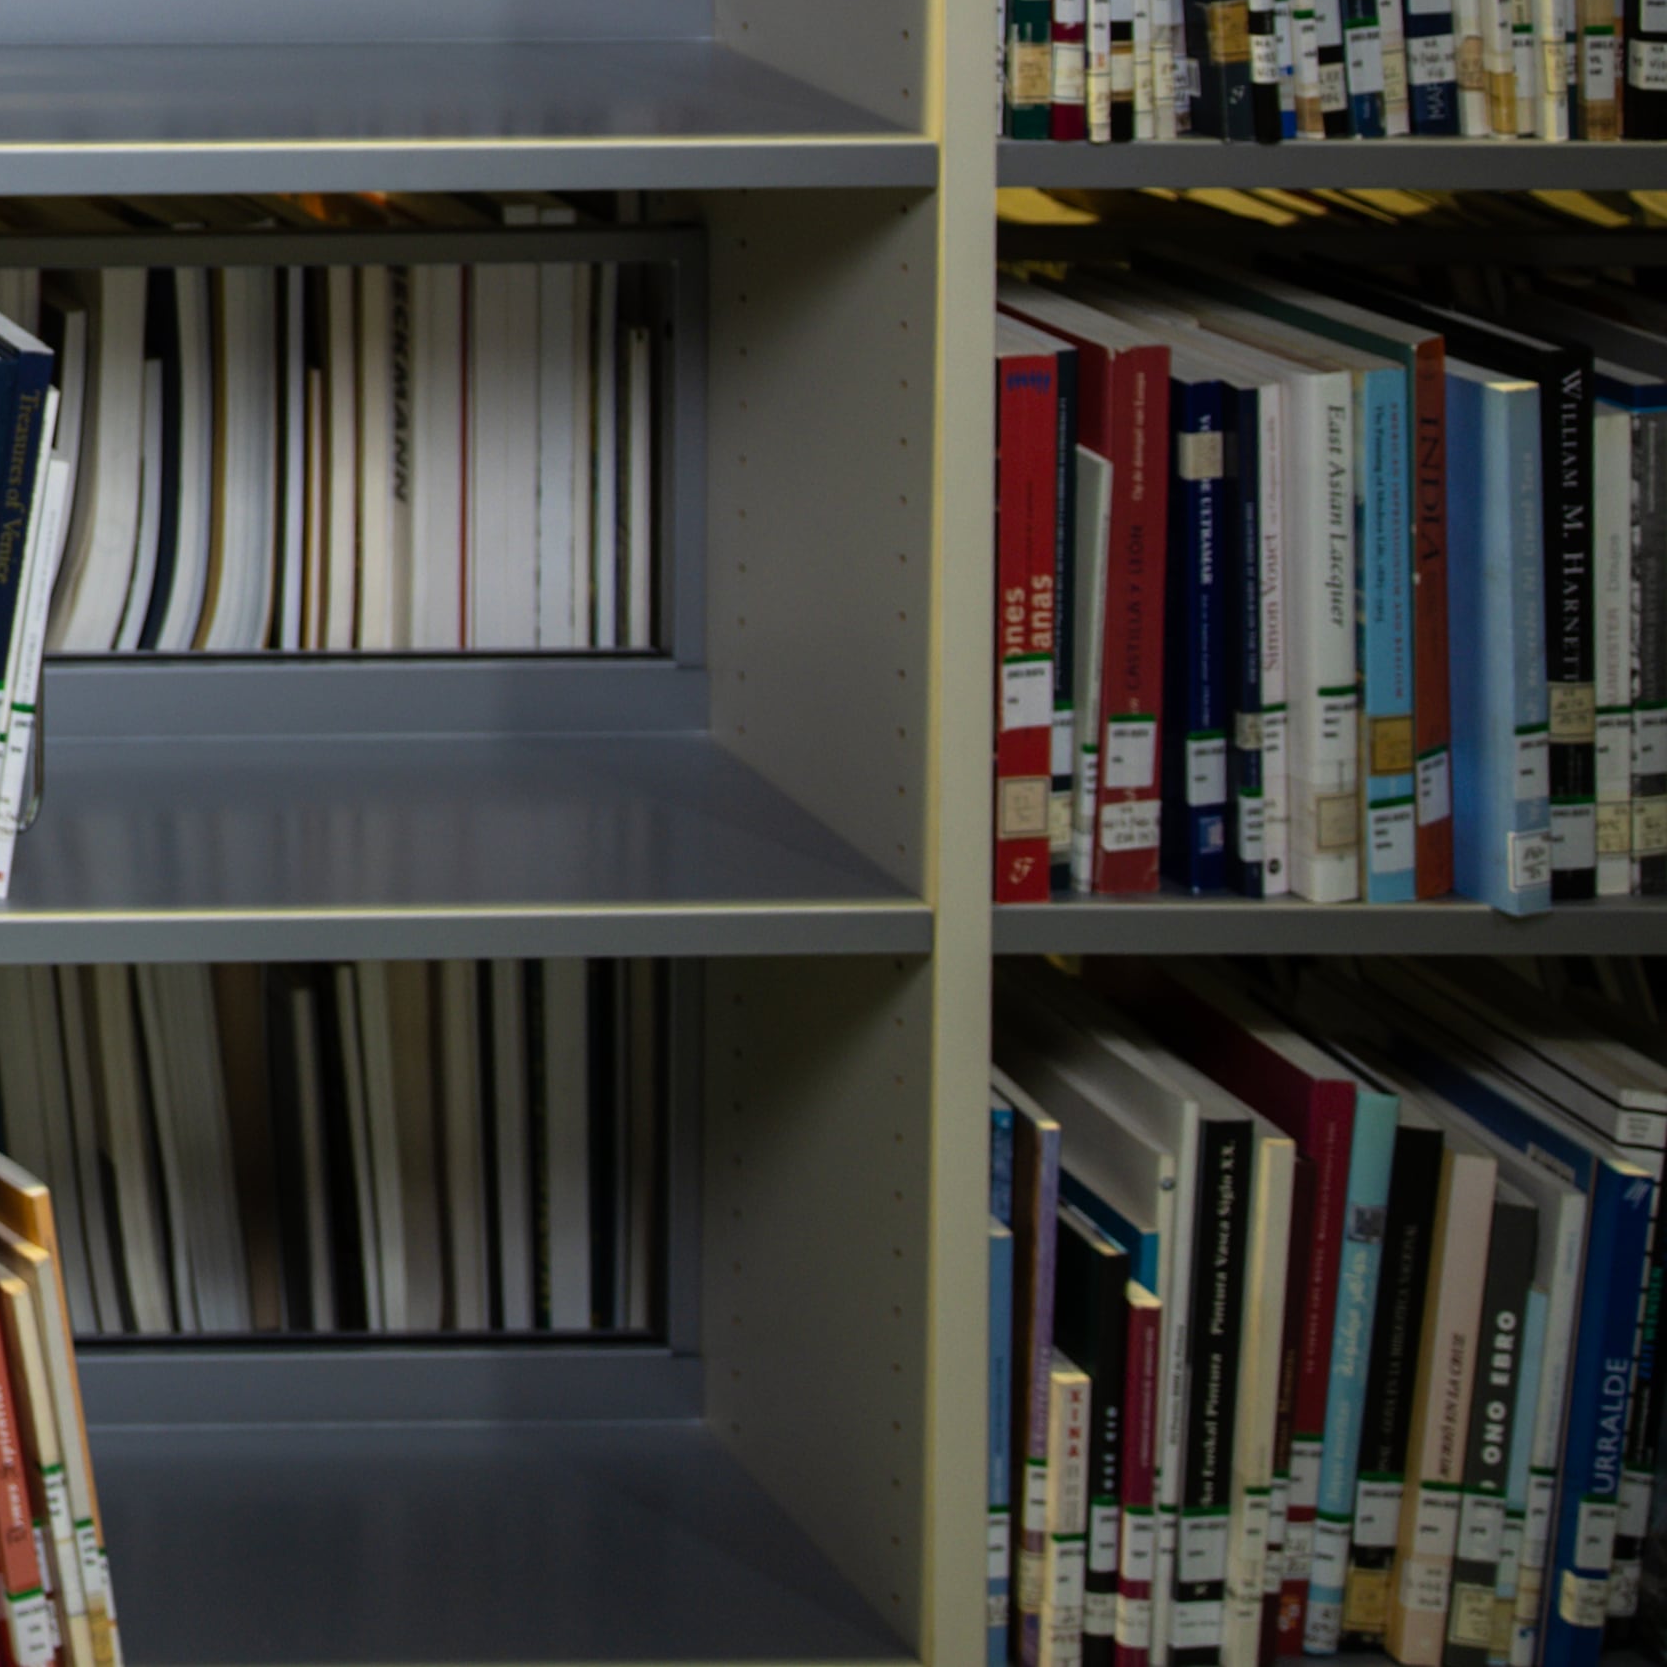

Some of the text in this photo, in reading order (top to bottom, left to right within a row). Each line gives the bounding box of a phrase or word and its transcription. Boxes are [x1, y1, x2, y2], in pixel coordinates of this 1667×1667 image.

[7, 391, 40, 487] Treasures
[1561, 368, 1583, 486] WILLIAM
[4, 487, 27, 511] of
[1324, 405, 1349, 627] East Asian Lacquer
[1562, 505, 1584, 536] M.
